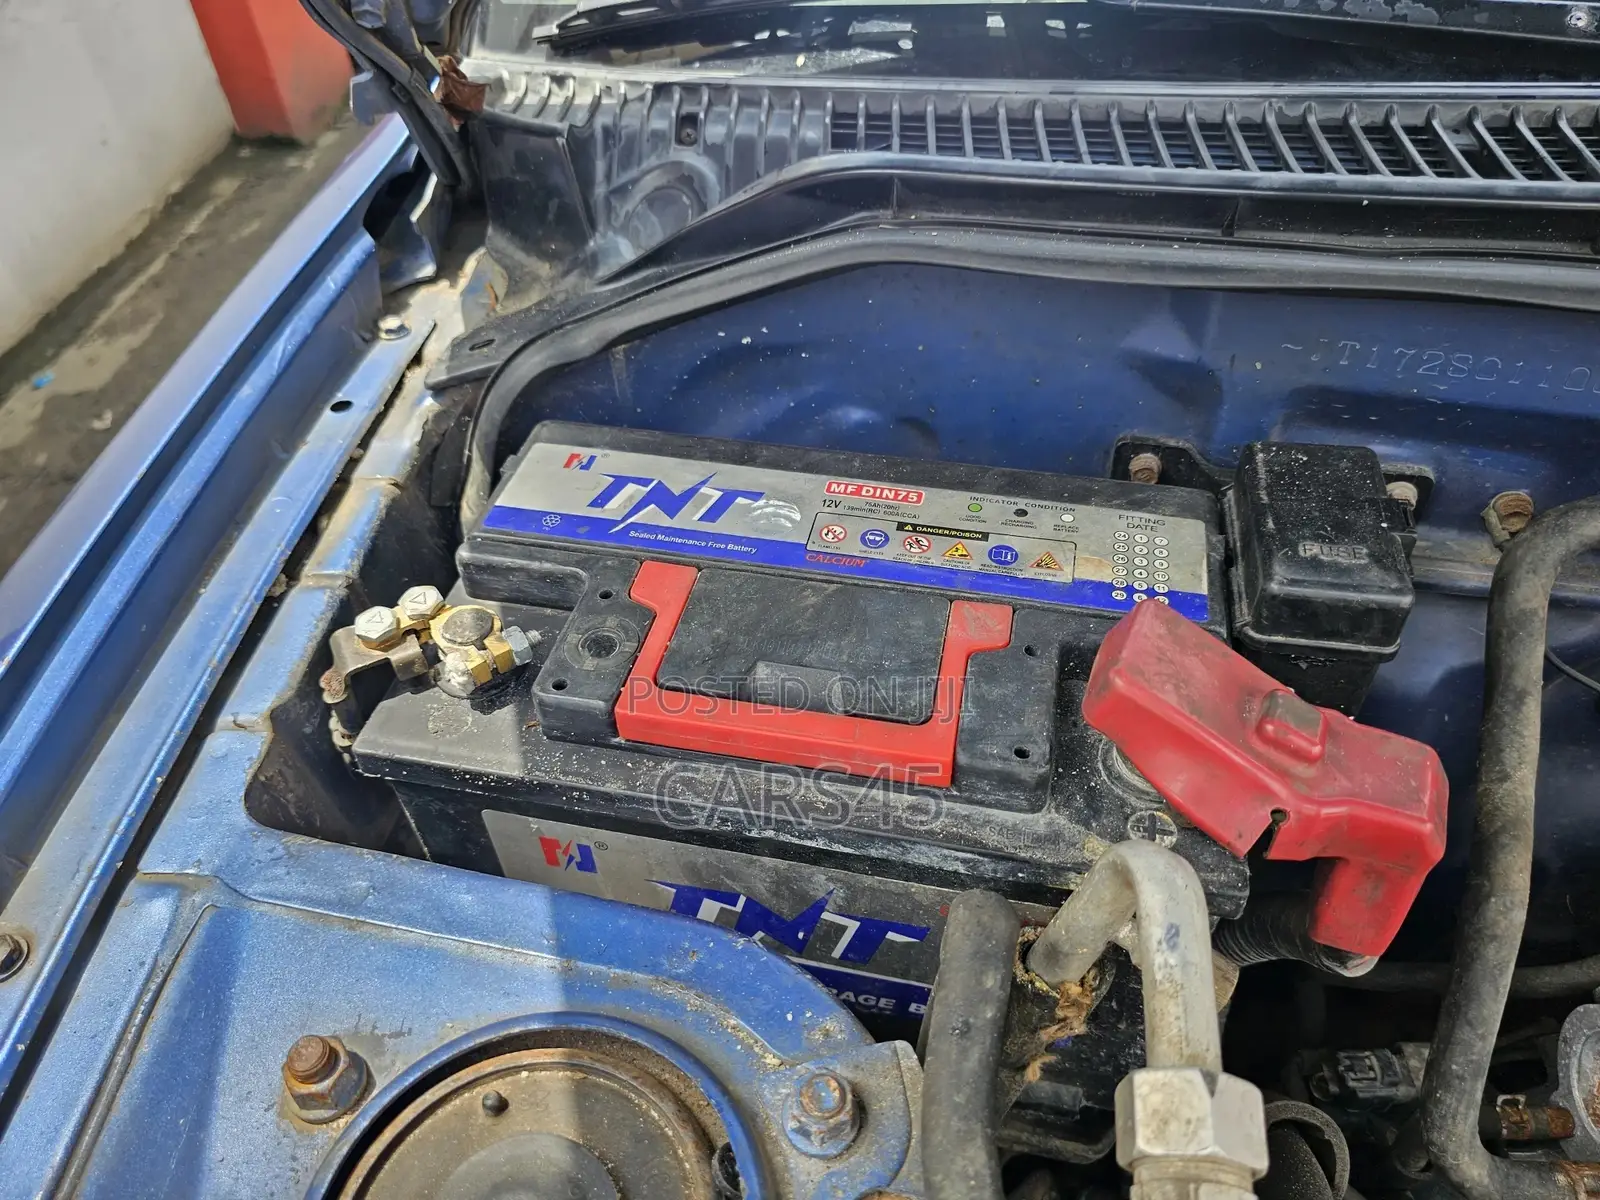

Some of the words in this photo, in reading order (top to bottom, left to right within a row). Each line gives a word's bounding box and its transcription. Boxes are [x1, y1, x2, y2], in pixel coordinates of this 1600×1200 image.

[830, 483, 859, 495] MF
[861, 486, 919, 503] DIN75
[586, 471, 766, 534] TNT
[821, 499, 842, 509] 12V
[864, 501, 900, 511] 75Ah(20hr)
[969, 496, 1019, 507] INDICATOR
[1024, 502, 1076, 513] CONDITION
[843, 505, 881, 515] 139min(RC)
[883, 509, 920, 520] 600A(CCA)
[1118, 514, 1166, 526] FITTING
[916, 525, 982, 539] DANGER/POISON
[1126, 522, 1158, 533] DATE
[628, 530, 656, 540] Sealed
[657, 534, 707, 547] Maintenance
[707, 541, 726, 549] Free
[727, 543, 758, 554] Battery
[1302, 543, 1366, 561] FUSE
[805, 553, 866, 568] CALCIUM
[645, 879, 931, 966] TNT
